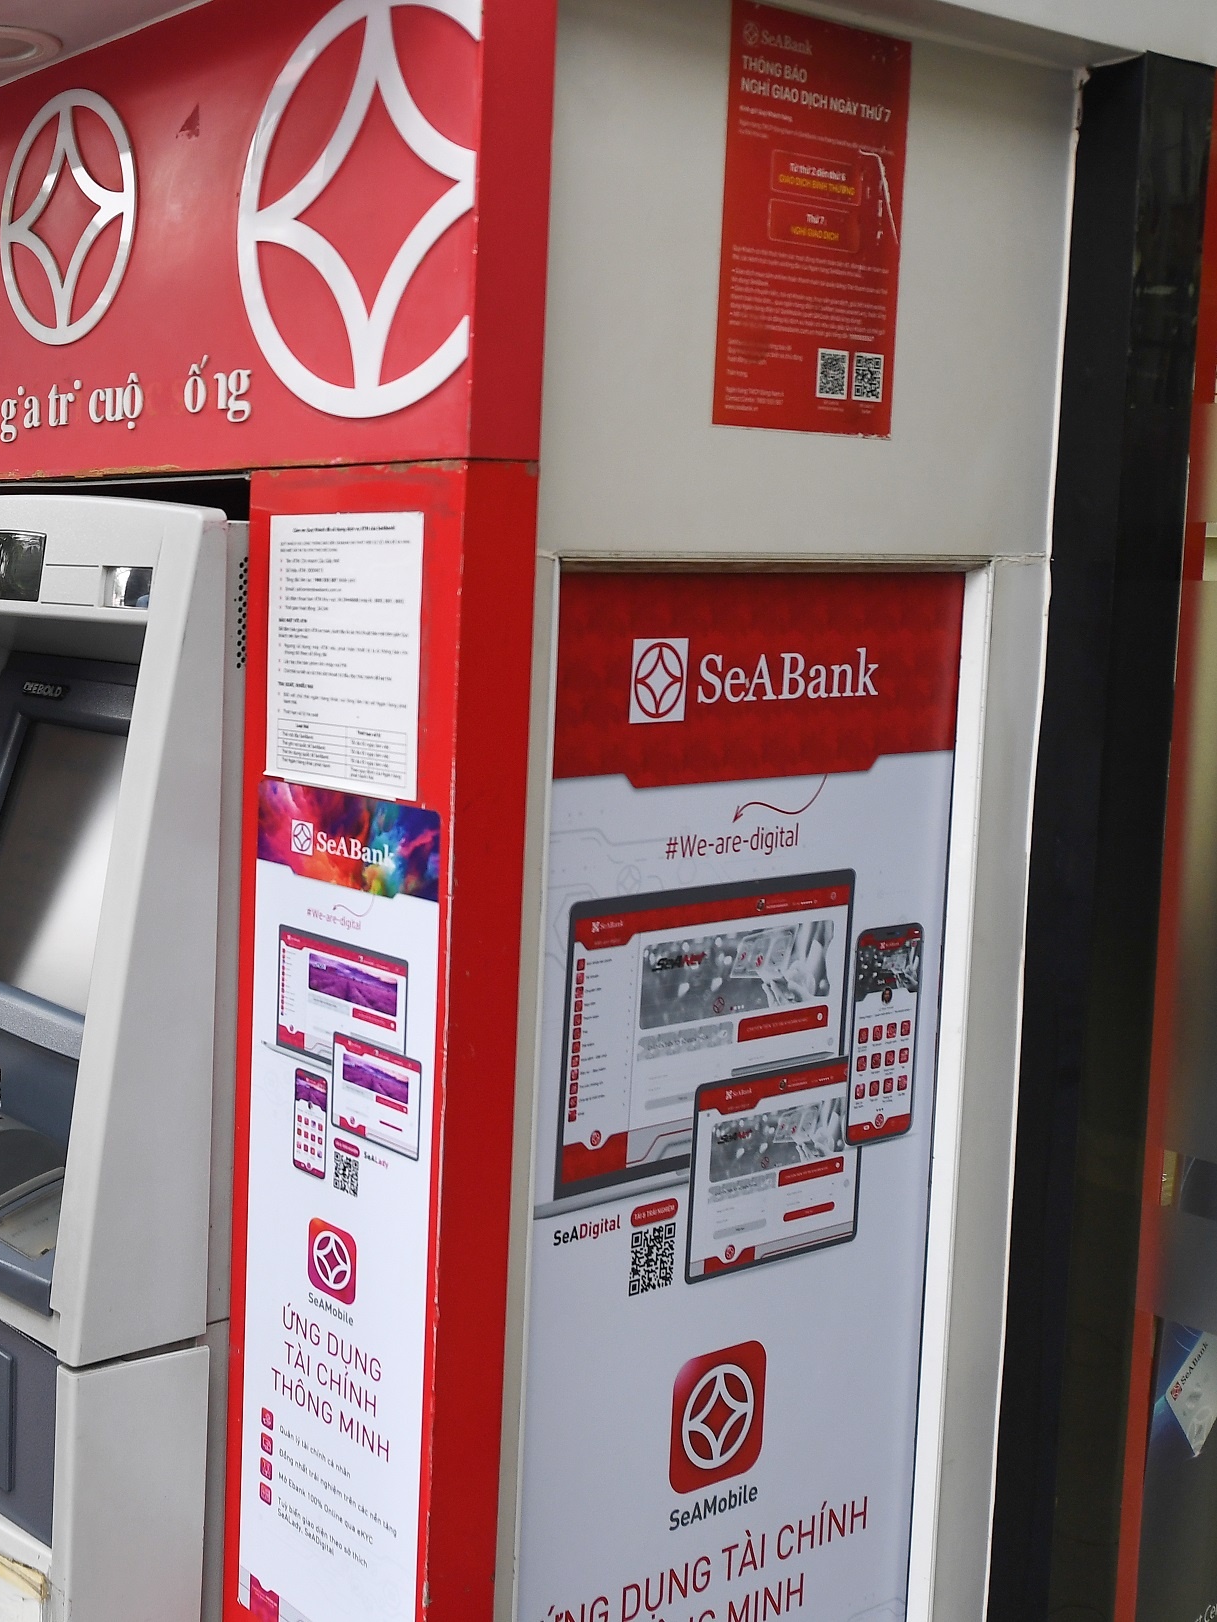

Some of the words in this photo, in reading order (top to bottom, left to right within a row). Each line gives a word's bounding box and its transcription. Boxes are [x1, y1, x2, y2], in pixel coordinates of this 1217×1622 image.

[761, 30, 813, 55] SeABank
[742, 55, 782, 77] THÔNG
[784, 63, 808, 83] BÁO
[772, 84, 799, 102] GIAO
[801, 91, 828, 109] DỊCH
[829, 97, 859, 116] NGÀY
[860, 102, 884, 121] THỨ
[885, 109, 891, 123] 7
[697, 647, 879, 705] SeABank
[316, 831, 395, 867] SeABank
[665, 823, 800, 860] #We-are-digital
[306, 907, 362, 930] #We-are-digital
[552, 1215, 621, 1247] SeADigital
[308, 1292, 354, 1326] SeAMobile
[282, 1302, 321, 1346] ỨNG
[327, 1331, 382, 1382] DỤNG
[284, 1341, 310, 1377] TÀI
[316, 1363, 377, 1418] CHÍNH
[271, 1367, 333, 1425] THÔNG
[339, 1410, 390, 1463] MINH
[669, 1484, 758, 1531] SeAMobile
[621, 1555, 711, 1622] DỤNG
[721, 1529, 766, 1581] TÀI
[776, 1496, 868, 1561] CHÍNH
[728, 1573, 805, 1622] MINH
